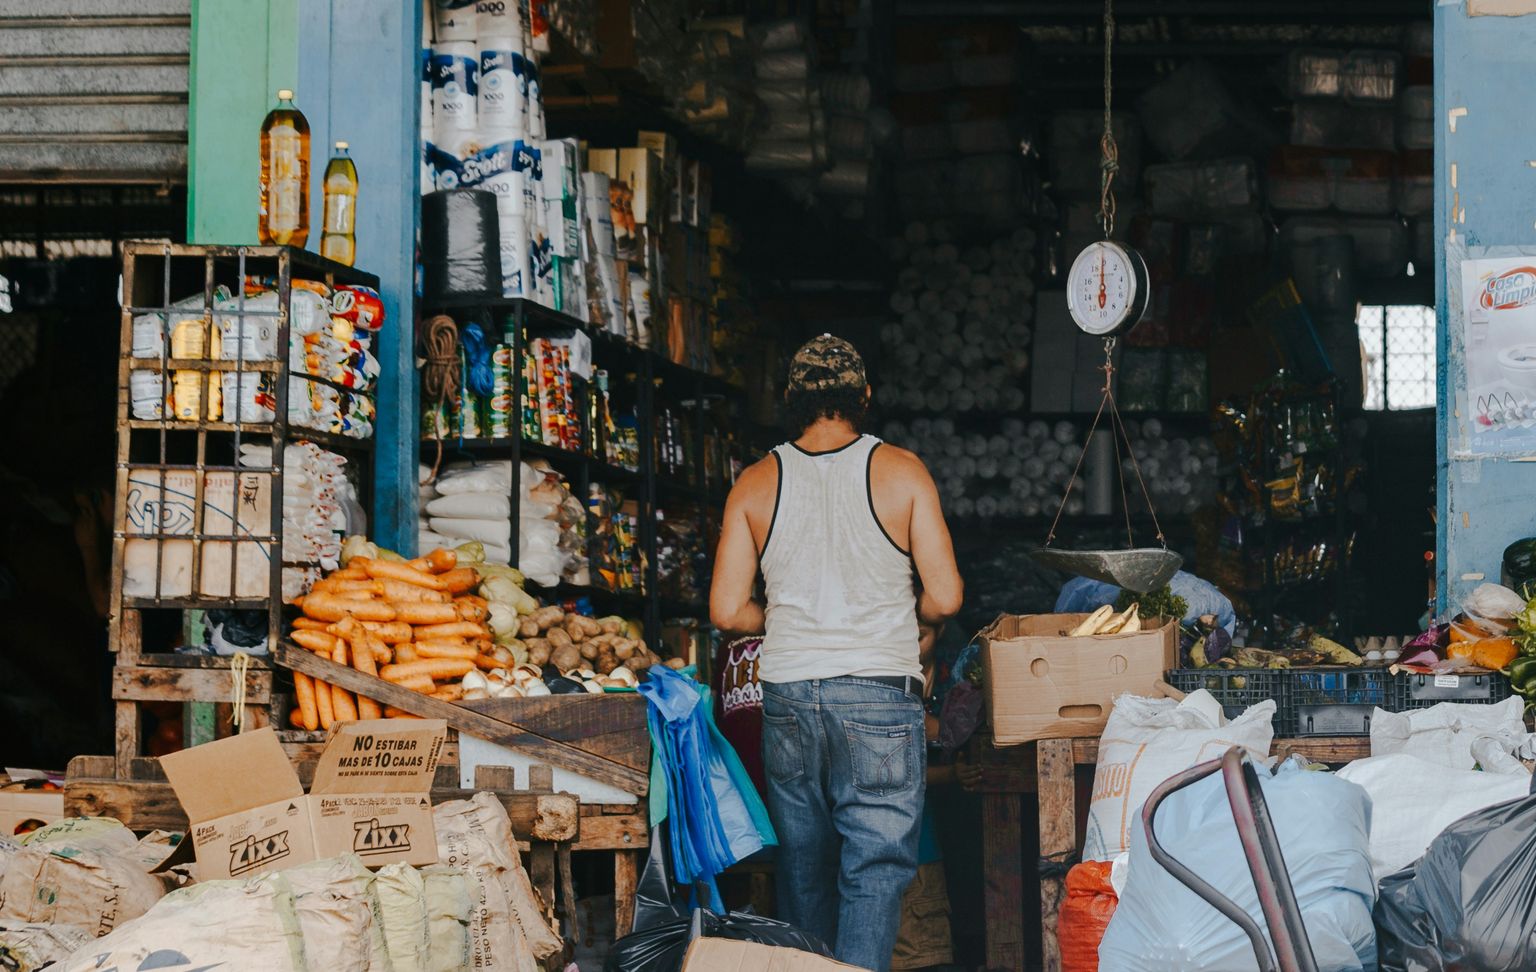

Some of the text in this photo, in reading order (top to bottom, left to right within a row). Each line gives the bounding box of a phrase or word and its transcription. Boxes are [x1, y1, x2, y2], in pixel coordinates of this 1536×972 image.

[461, 152, 508, 184] Scott
[1486, 273, 1524, 293] Casa
[353, 735, 417, 751] NO ESTIBAR
[338, 752, 423, 767] MAS DE 10 CAJAS
[201, 825, 215, 835] PACK
[353, 817, 411, 852] Zixx
[229, 830, 290, 874] Zixx
[479, 908, 491, 937] NETO
[481, 936, 493, 968] PESO
